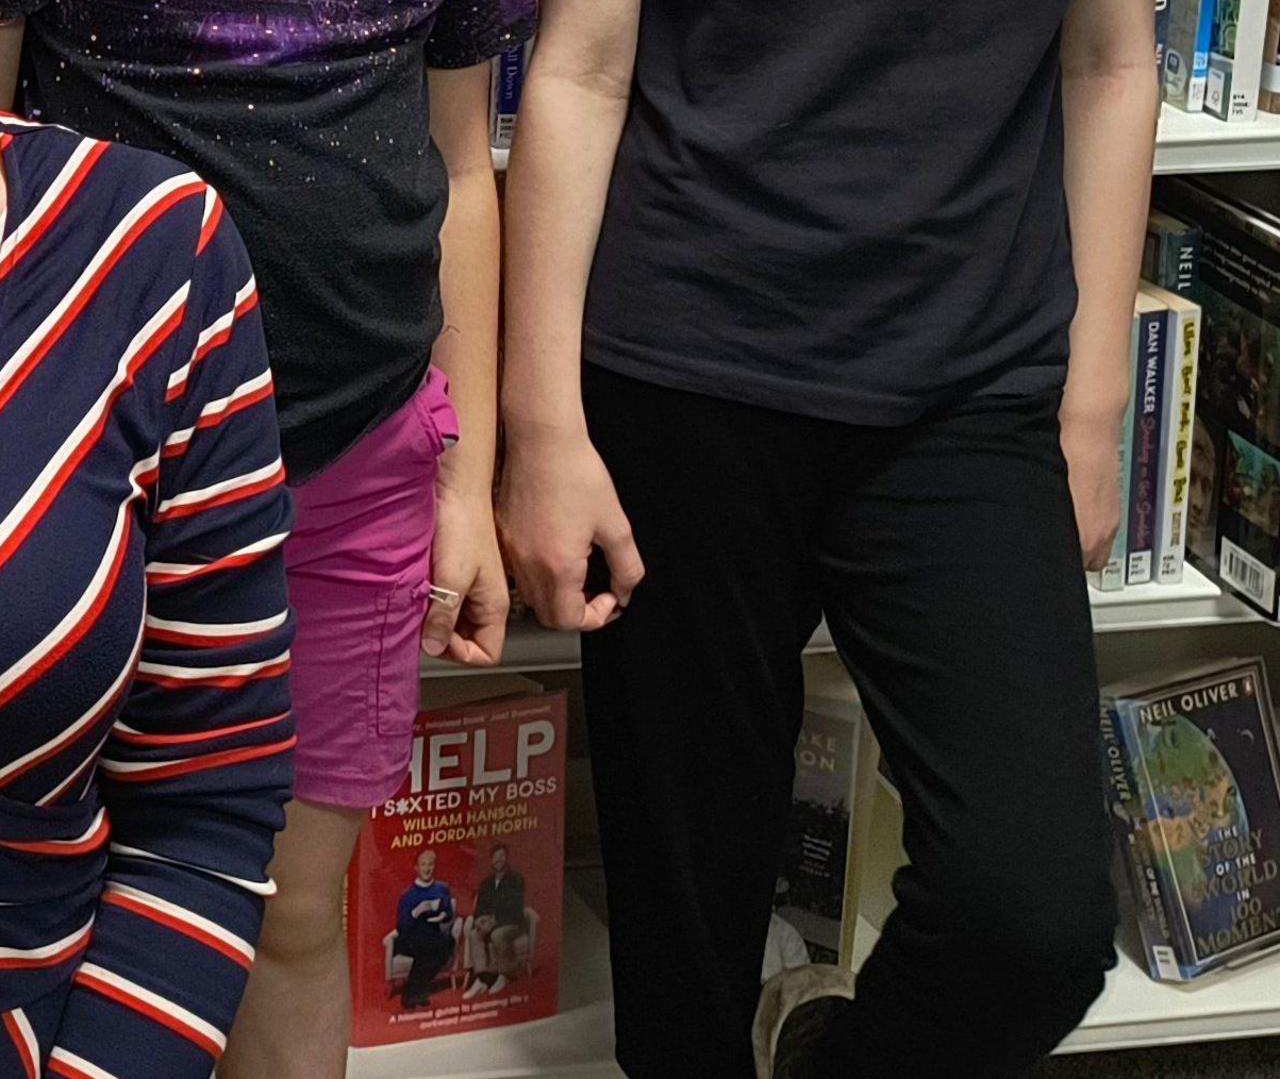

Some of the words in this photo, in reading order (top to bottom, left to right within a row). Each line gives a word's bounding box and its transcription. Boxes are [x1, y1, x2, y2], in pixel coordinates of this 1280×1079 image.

[1139, 700, 1178, 724] NEIL
[1181, 682, 1240, 714] OLIVER
[469, 786, 502, 807] MY
[506, 778, 557, 800] BOSS
[402, 815, 463, 832] WILLIAM
[466, 802, 528, 824] HANSON
[391, 833, 423, 848] AND
[427, 824, 488, 843] JORDAN
[492, 817, 538, 835] NORTH
